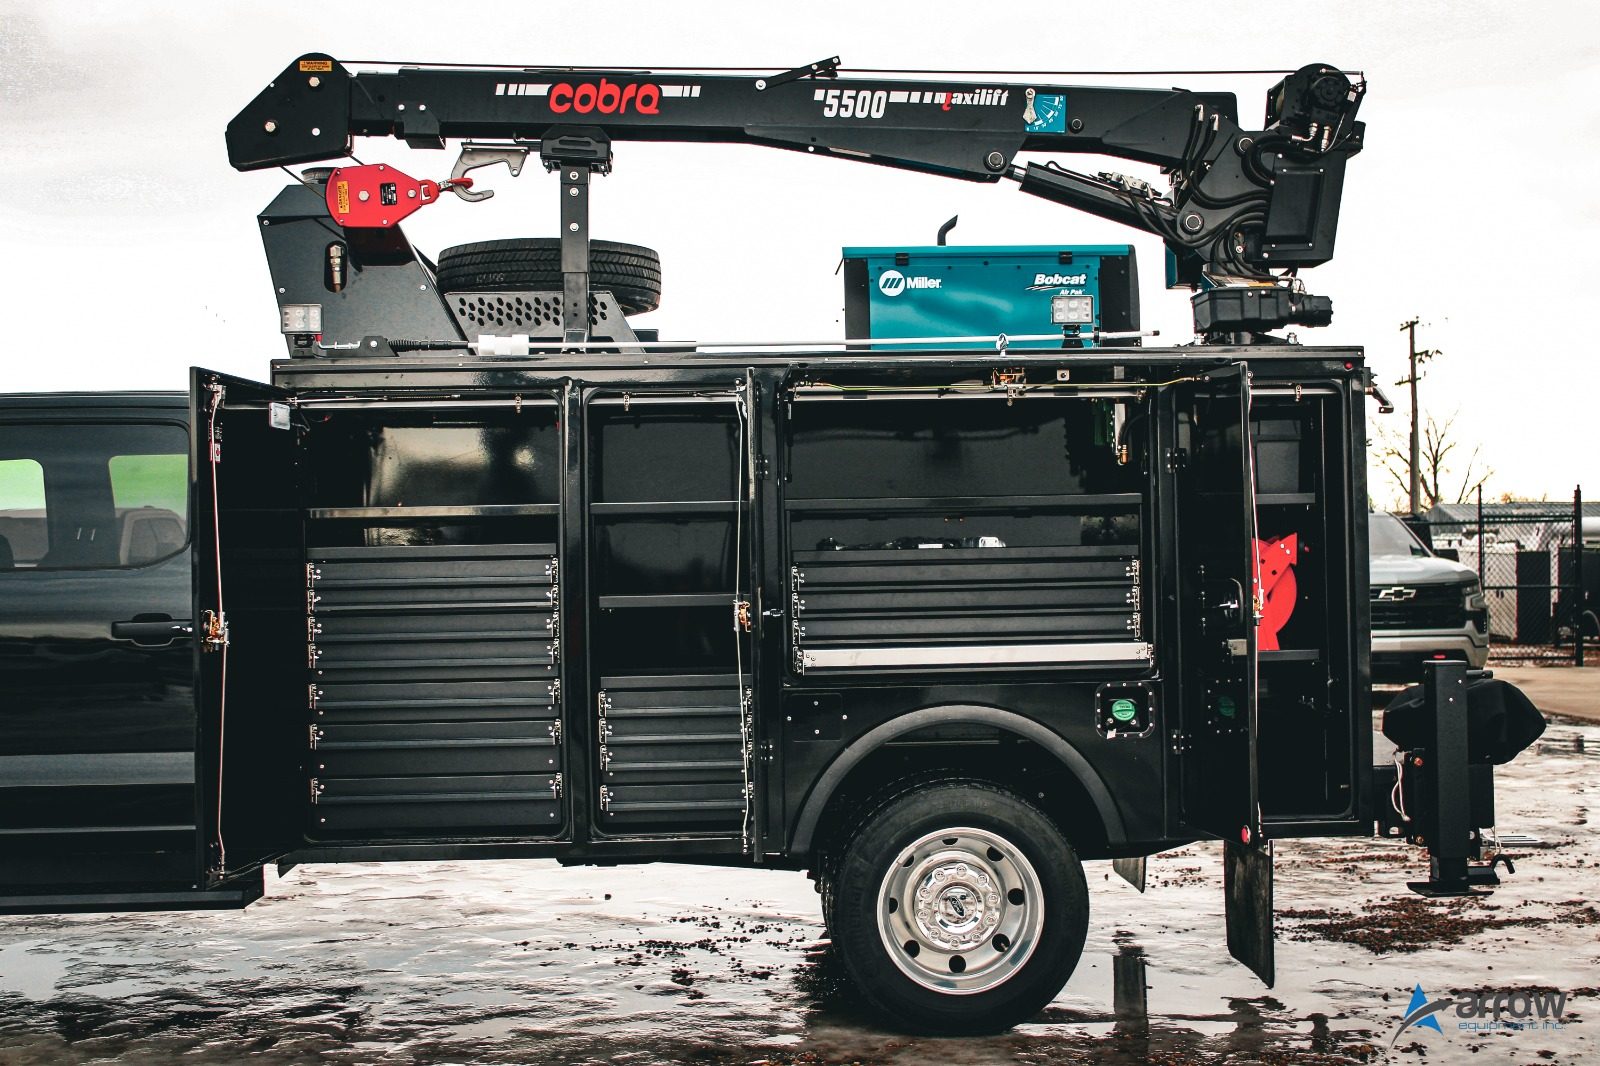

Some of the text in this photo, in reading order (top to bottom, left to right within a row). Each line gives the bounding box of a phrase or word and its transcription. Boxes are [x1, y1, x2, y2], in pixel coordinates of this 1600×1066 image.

[549, 78, 660, 114] cobra
[824, 89, 887, 118] 5500
[1033, 273, 1087, 285] Bobcat
